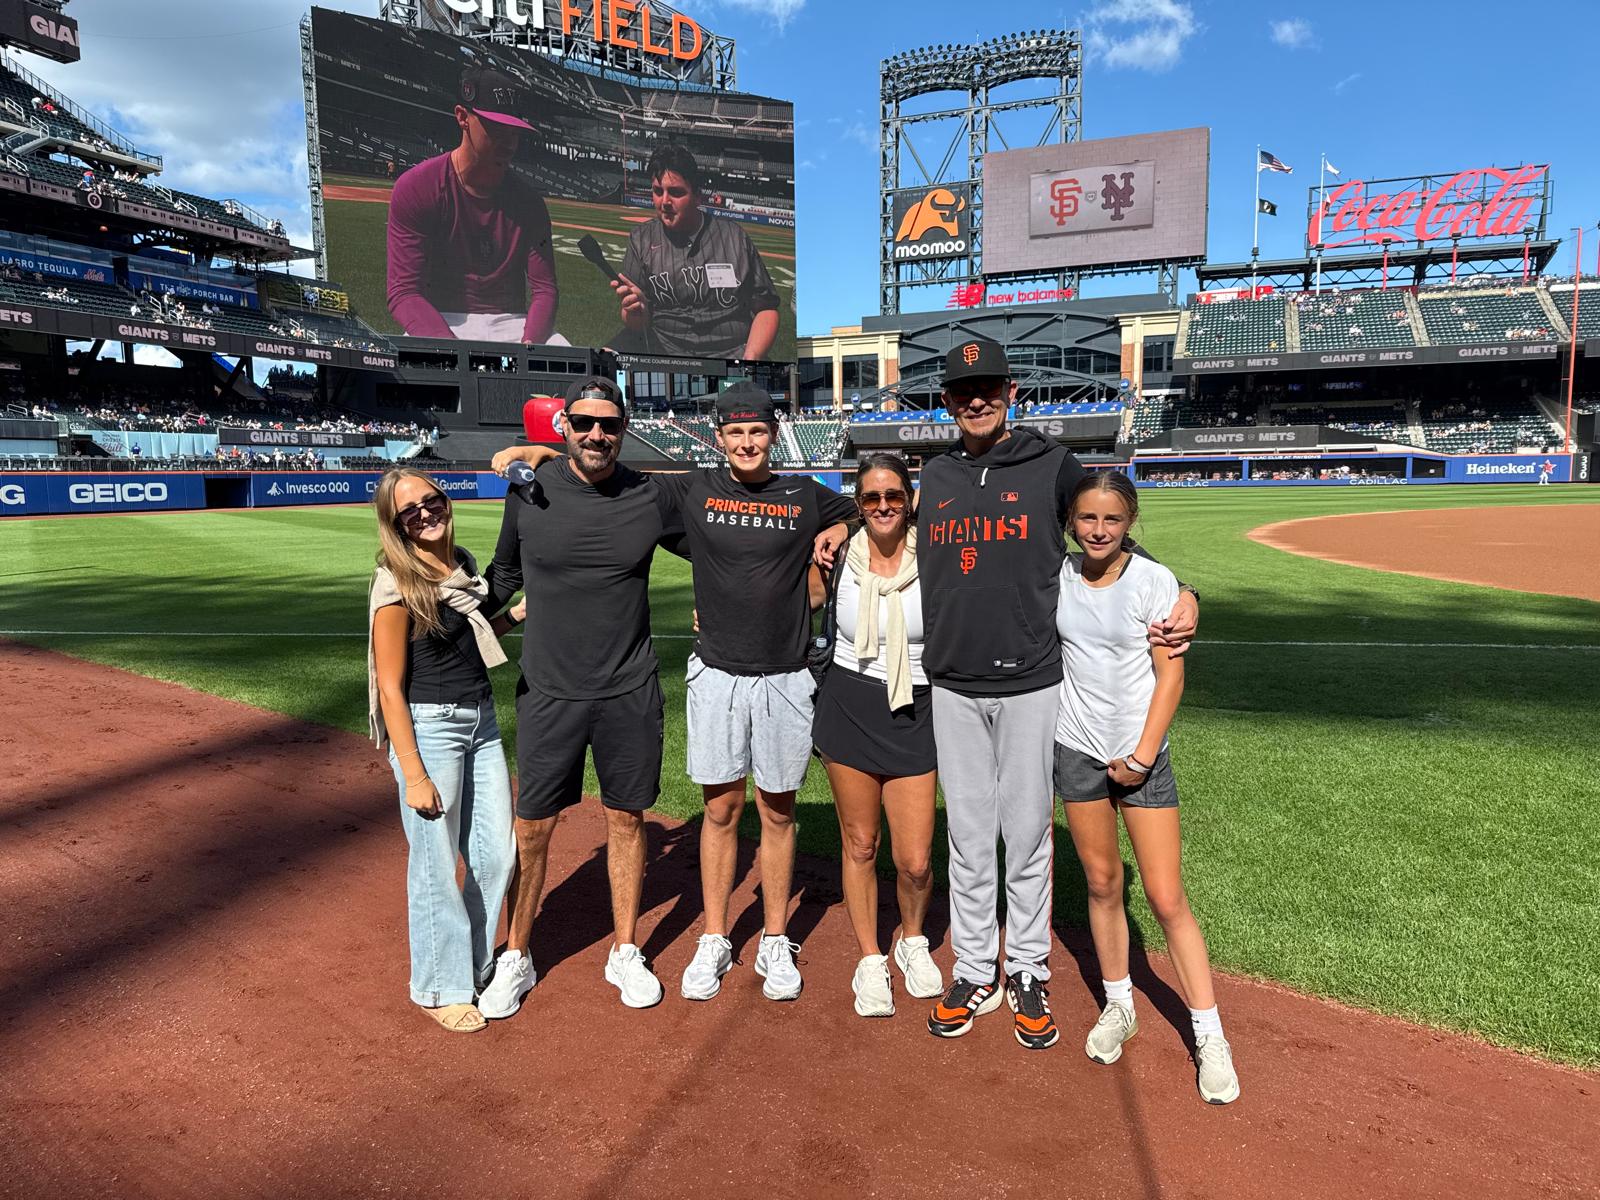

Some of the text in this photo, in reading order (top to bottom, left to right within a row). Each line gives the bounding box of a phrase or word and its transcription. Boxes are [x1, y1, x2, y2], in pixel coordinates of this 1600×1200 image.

[561, 0, 702, 60] FIELD
[1049, 172, 1135, 226] SF NY
[895, 239, 966, 258] moomoo
[37, 262, 78, 276] TEQUILA
[193, 288, 218, 300] PORCH
[219, 293, 234, 303] BAR
[988, 293, 1014, 305] new
[1017, 288, 1073, 303] balance
[0, 309, 33, 324] ETS
[118, 324, 216, 347] GIANTS METS
[255, 342, 332, 360] GIANTS METS
[963, 343, 980, 366] SF
[1320, 351, 1414, 364] GIANTS METS
[1459, 343, 1557, 357] GIANTS METS
[363, 355, 395, 368] GIANTS
[1192, 357, 1279, 370] GIANTS METS
[250, 431, 344, 445] GIANTS METS
[899, 420, 1064, 441] GIANT TS
[1195, 431, 1296, 443] GIANTS METS
[1466, 461, 1535, 476] Heineken
[1579, 456, 1588, 480] 330
[286, 481, 350, 494] Invesco QQQ
[440, 479, 479, 490] Guardian
[840, 484, 856, 494] 380
[0, 482, 168, 505] G GEICO
[704, 498, 788, 518] PRINCETON
[706, 511, 797, 530] BASEBALL
[929, 514, 1028, 547] GIANTS
[960, 546, 978, 575] SF
